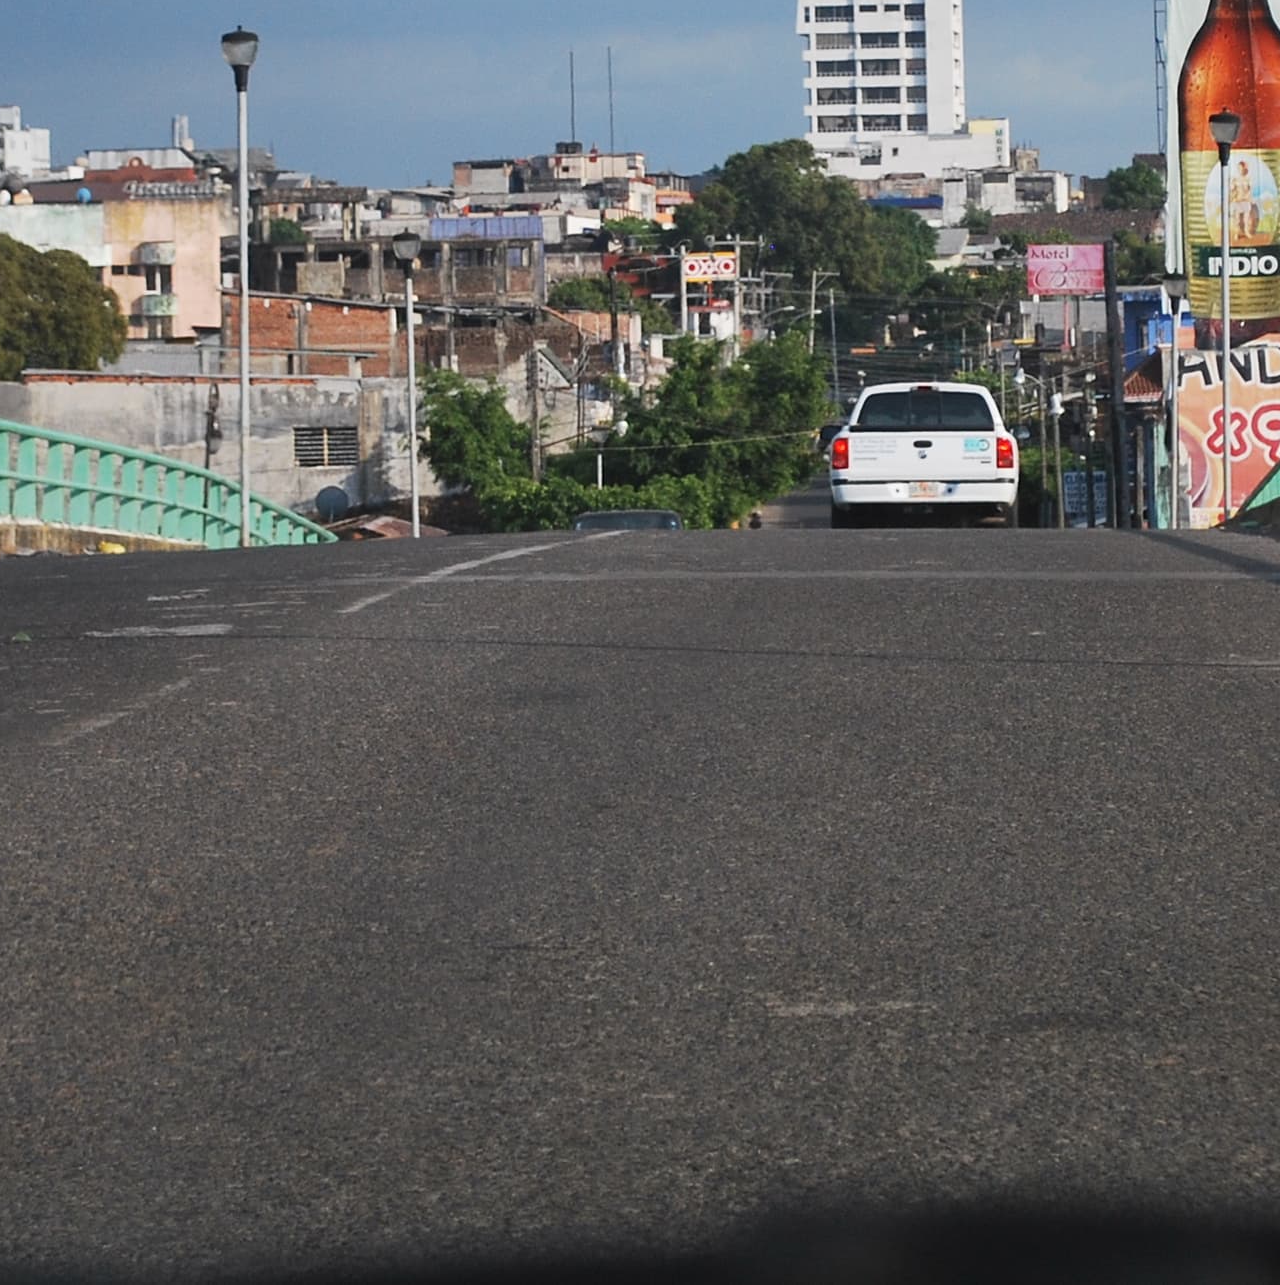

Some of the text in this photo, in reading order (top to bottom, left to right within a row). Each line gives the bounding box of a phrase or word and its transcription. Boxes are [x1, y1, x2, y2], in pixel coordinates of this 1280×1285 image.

[1030, 247, 1069, 259] Motel
[683, 257, 736, 276] OXXO
[1208, 255, 1278, 276] INDIO
